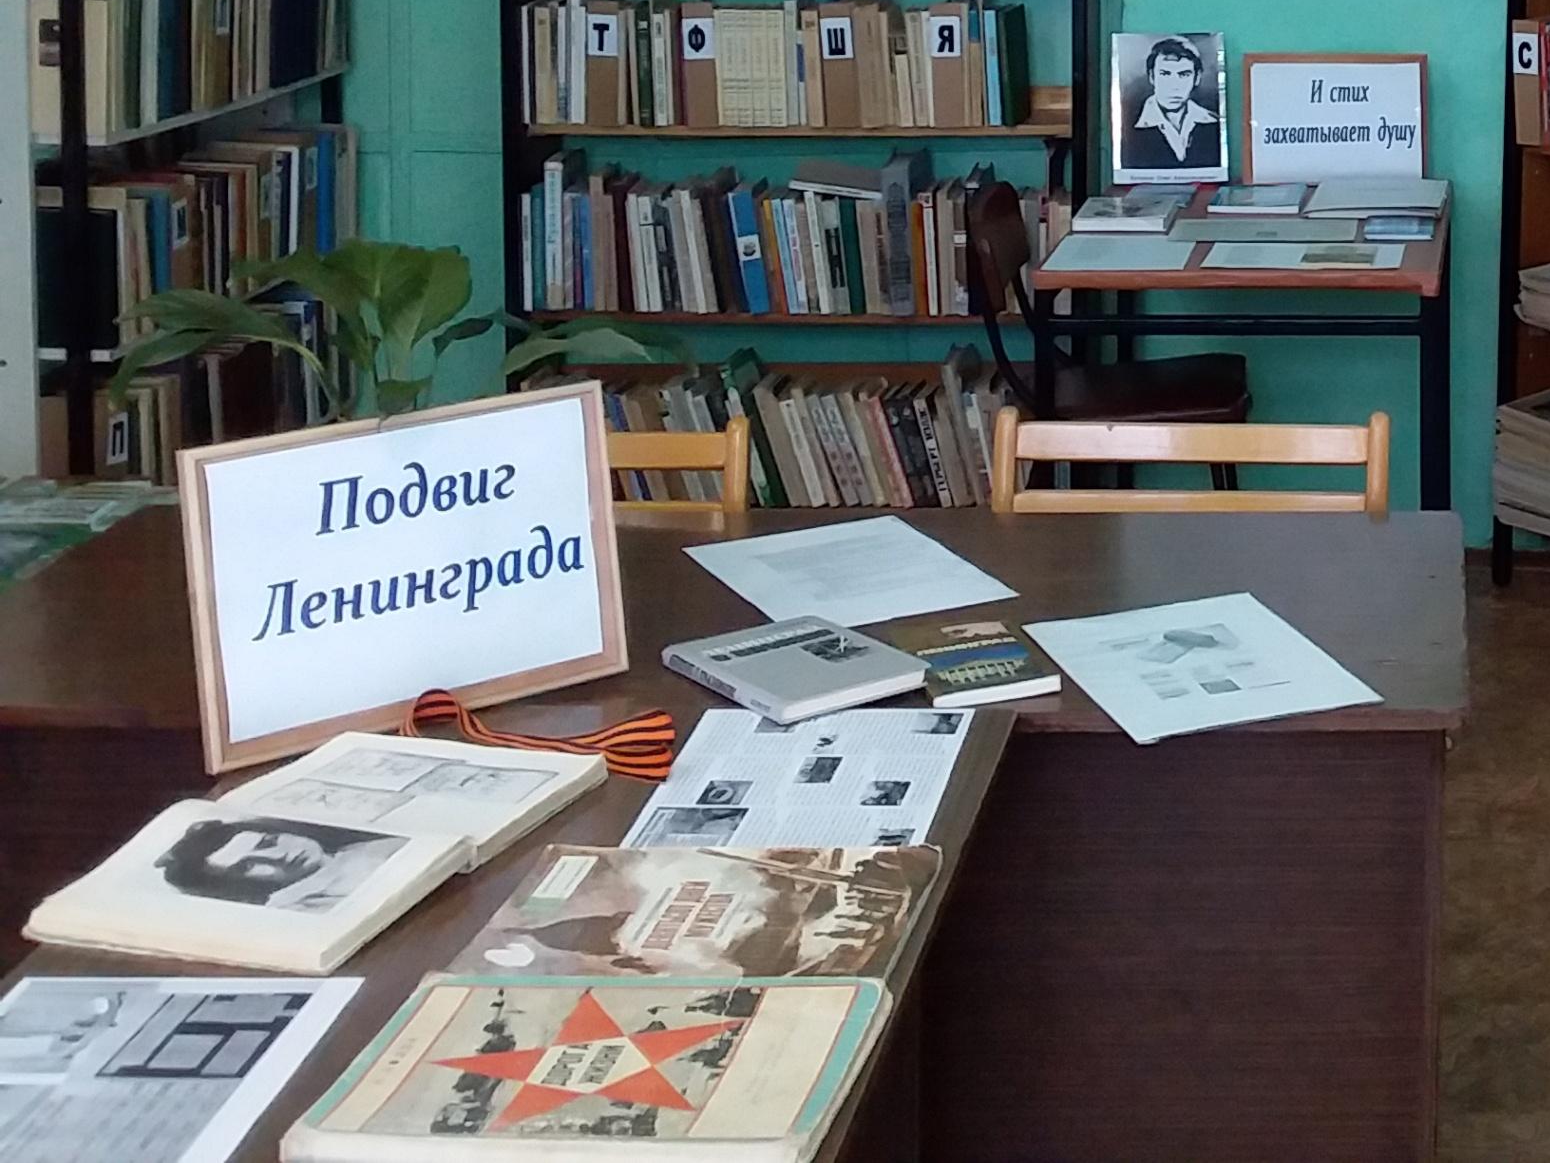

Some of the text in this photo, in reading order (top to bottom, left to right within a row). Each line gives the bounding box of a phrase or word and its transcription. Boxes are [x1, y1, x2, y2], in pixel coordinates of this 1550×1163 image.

[593, 23, 609, 51] Т
[688, 25, 705, 52] Ф
[827, 28, 846, 55] Ш
[938, 25, 954, 52] Я
[1518, 42, 1532, 69] С
[1310, 79, 1370, 103] И стих
[1264, 117, 1417, 149] захватывает душу
[112, 421, 124, 456] П
[315, 462, 515, 536] Подвиг
[251, 525, 585, 642] Ленинграда
